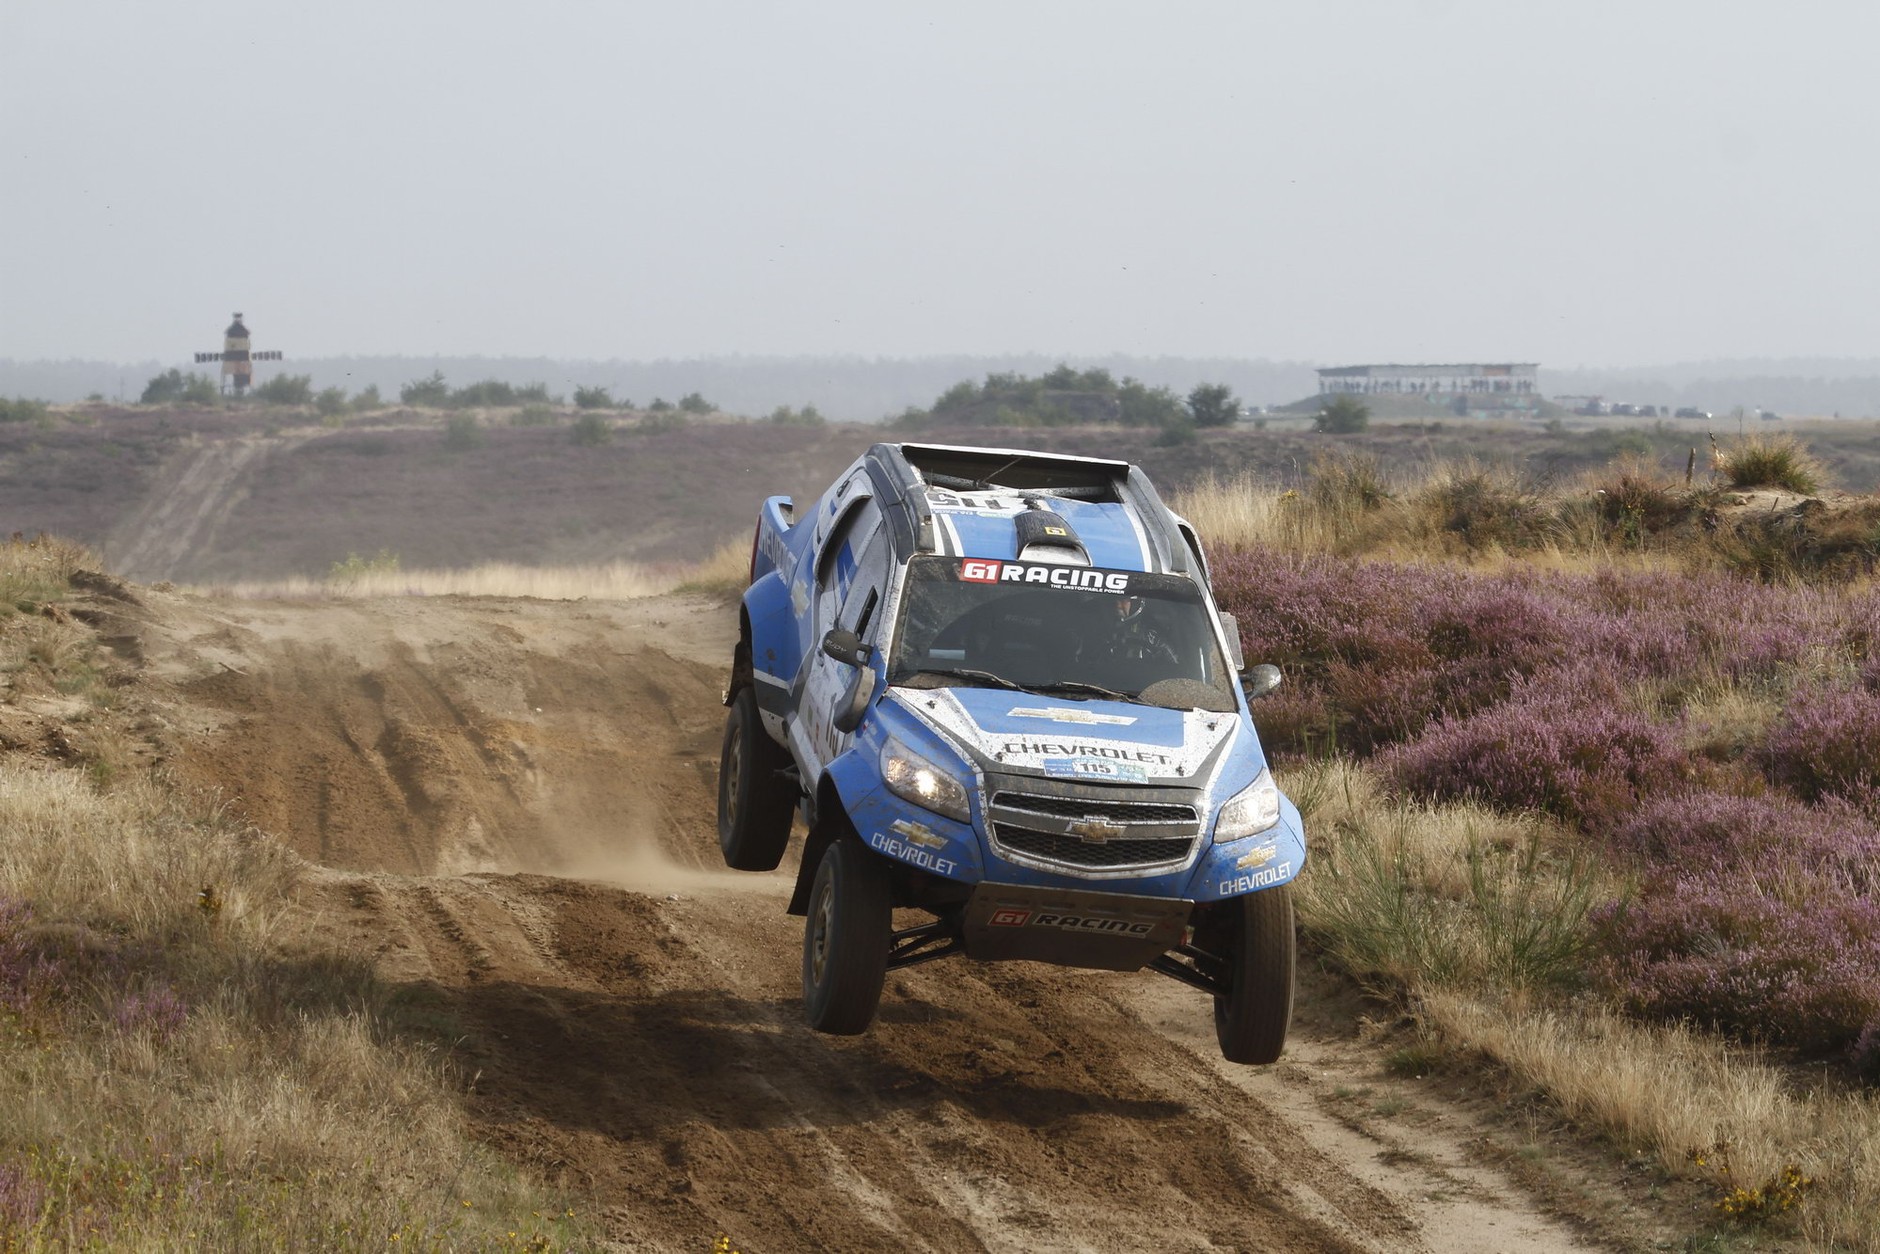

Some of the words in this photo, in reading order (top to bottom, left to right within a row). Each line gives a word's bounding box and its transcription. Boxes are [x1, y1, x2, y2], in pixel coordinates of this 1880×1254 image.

[964, 562, 998, 580] G1
[1001, 564, 1129, 590] RACING
[1062, 584, 1103, 593] UNSTOPPABLE
[1004, 743, 1171, 765] CHEVROLET
[1080, 763, 1112, 774] 115
[871, 832, 958, 875] CHEVROLET
[1220, 861, 1291, 895] CHEVROLET
[995, 912, 1026, 924] G1
[1035, 914, 1152, 933] RACING
